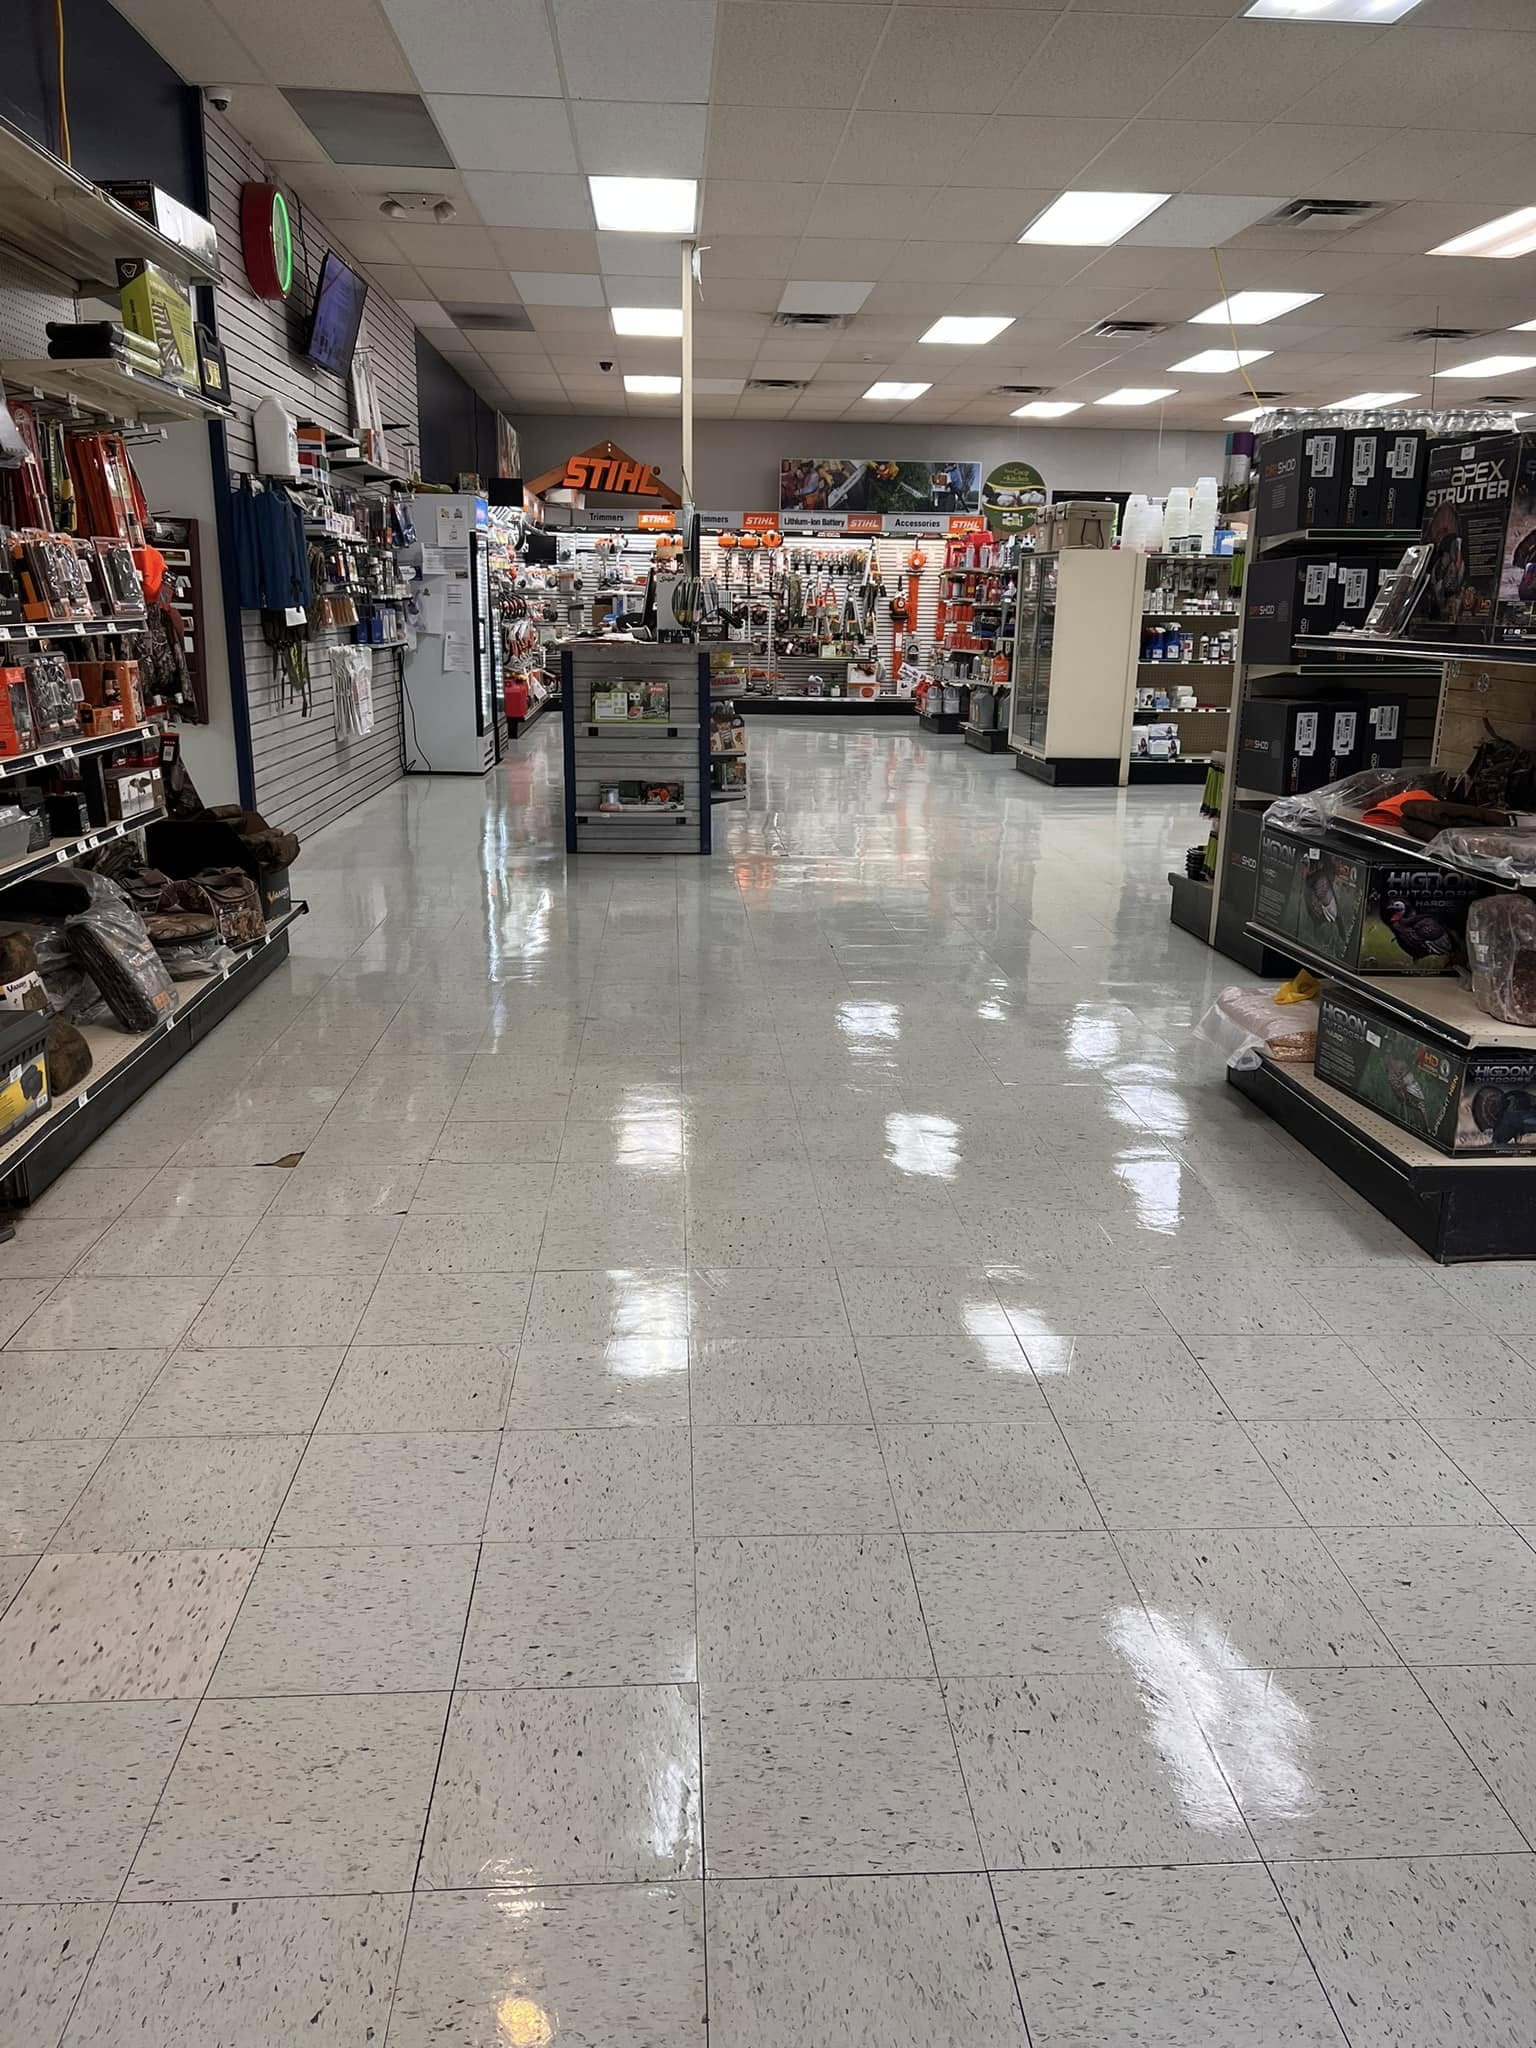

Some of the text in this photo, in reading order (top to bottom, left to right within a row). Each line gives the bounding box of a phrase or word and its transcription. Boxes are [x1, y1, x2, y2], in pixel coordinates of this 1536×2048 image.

[563, 455, 660, 495] STIHL
[1425, 479, 1509, 507] STRUTTER
[589, 512, 625, 522] Trimmers
[640, 514, 672, 524] STIHL
[701, 514, 729, 524] immers
[745, 516, 775, 525] STIHL
[822, 517, 845, 528] Battery
[850, 519, 879, 528] STIHL
[894, 518, 940, 528] Accessories
[951, 520, 980, 529] STIHL
[1474, 1065, 1534, 1077] HIGDON
